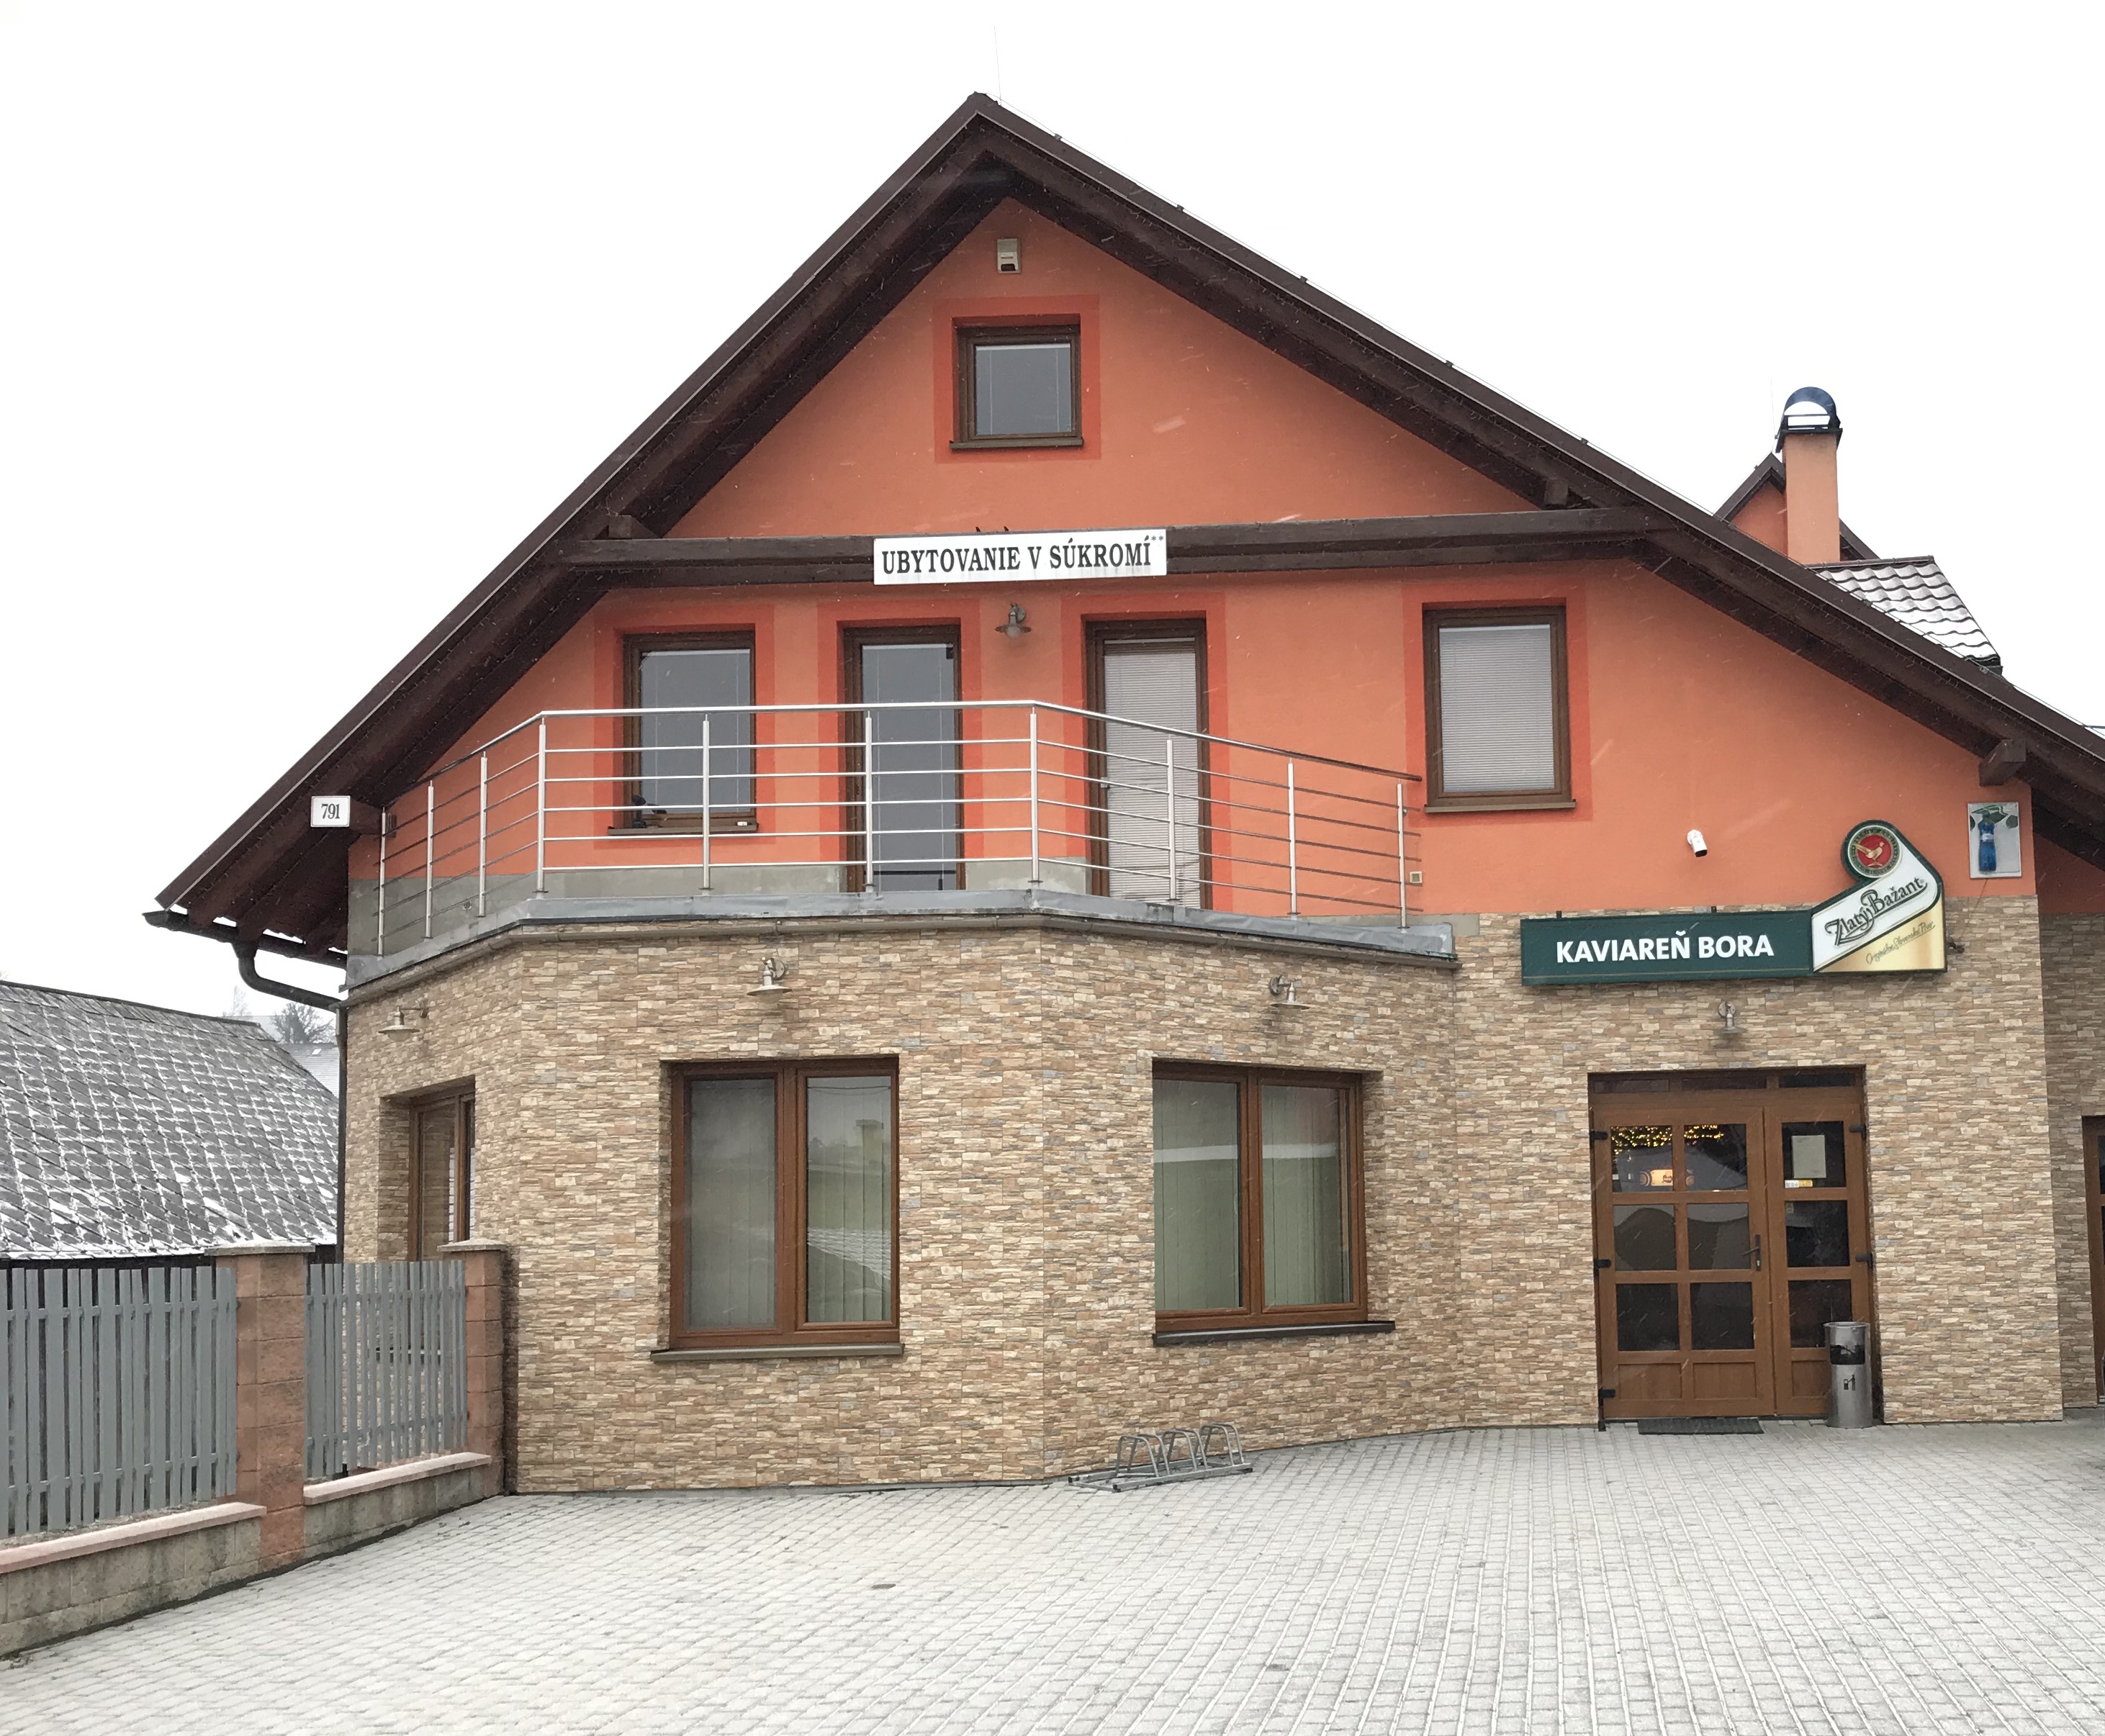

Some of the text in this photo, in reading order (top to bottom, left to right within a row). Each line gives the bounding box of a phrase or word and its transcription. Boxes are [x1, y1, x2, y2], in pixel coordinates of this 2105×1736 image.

[882, 535, 1151, 574] UBYTOVANIE V SÚKROMÍ
[321, 803, 341, 819] 791
[1824, 876, 1927, 947] Zlatý Bažant
[1556, 930, 1775, 963] KAVIAREŇ BORA
